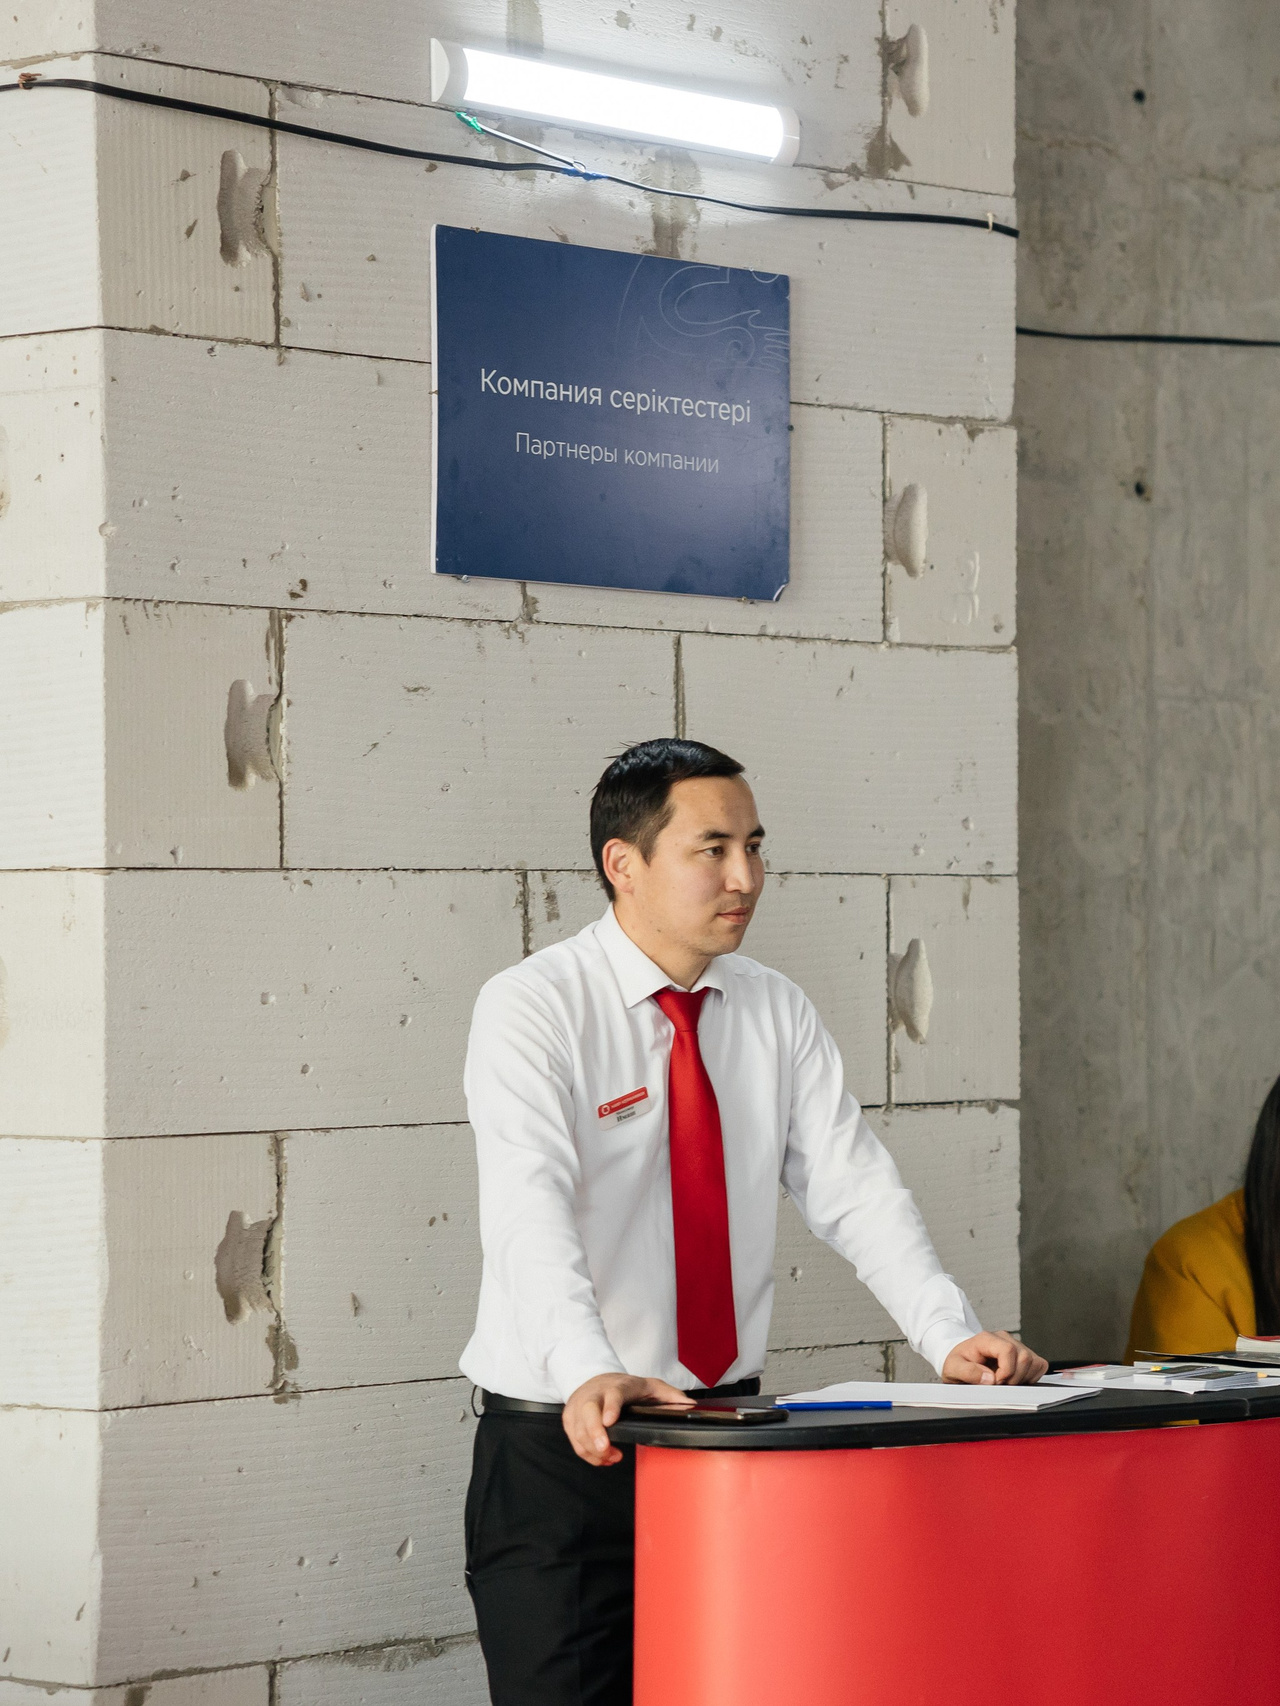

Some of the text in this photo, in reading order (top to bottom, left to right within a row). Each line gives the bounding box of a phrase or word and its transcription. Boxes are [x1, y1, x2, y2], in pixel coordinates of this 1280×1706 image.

[480, 367, 751, 426] Компания серіктестері
[515, 431, 719, 474] Партнеры компании
